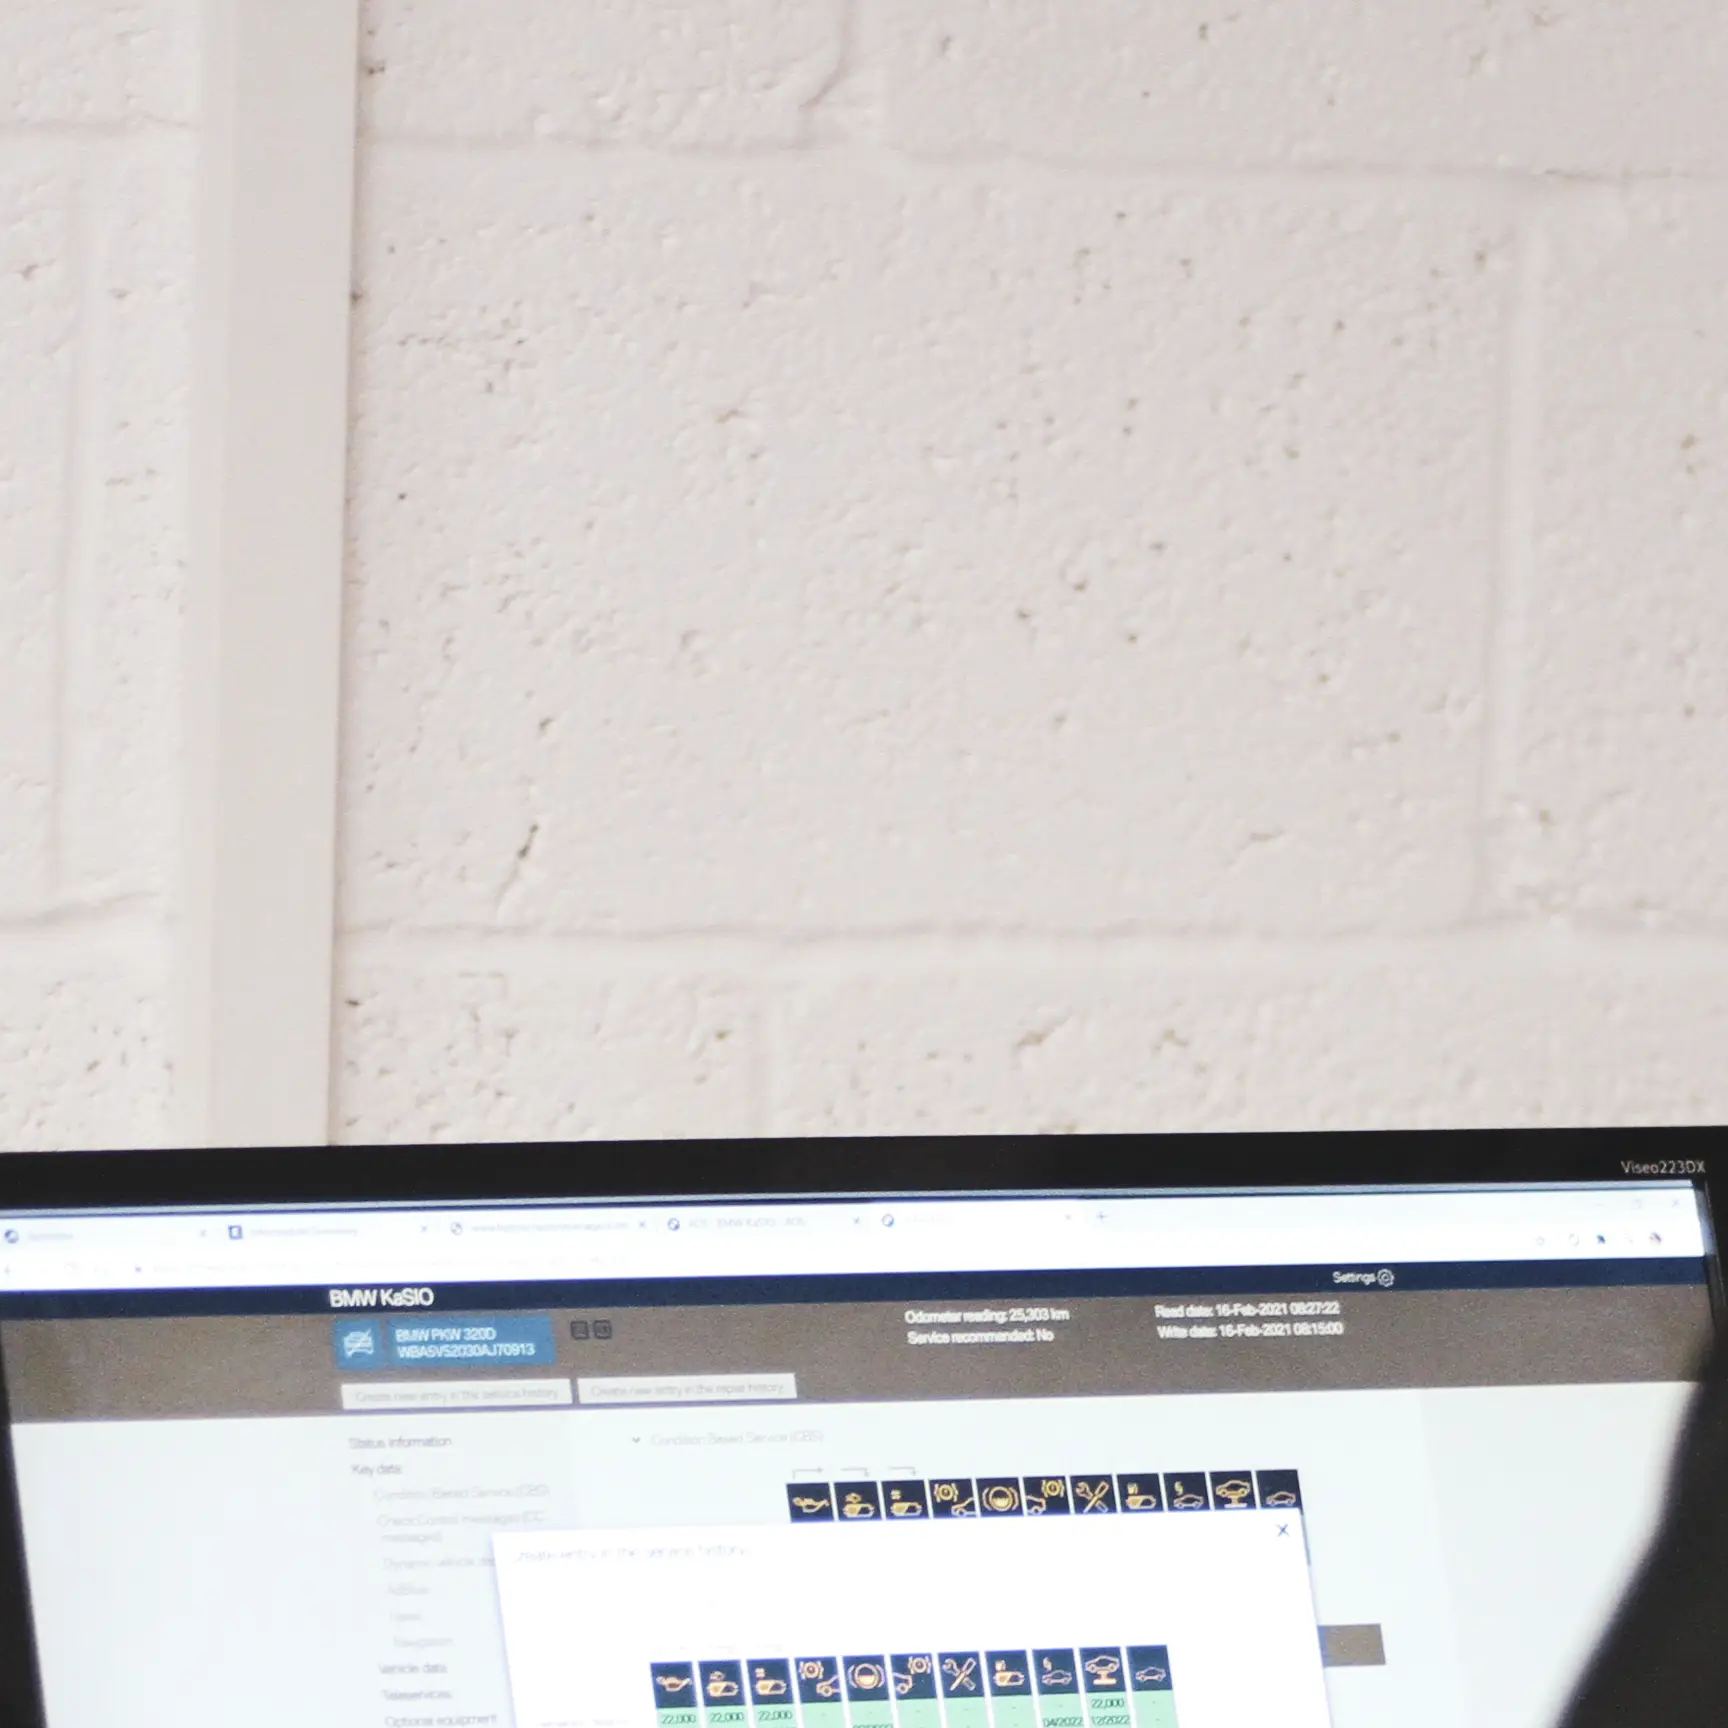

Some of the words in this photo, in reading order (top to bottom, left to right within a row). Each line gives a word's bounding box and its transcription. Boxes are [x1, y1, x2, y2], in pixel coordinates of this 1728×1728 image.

[1332, 1271, 1376, 1285] Settings
[329, 1289, 377, 1307] BMW
[380, 1287, 434, 1306] KaSIO
[904, 1310, 962, 1324] Odometer
[1154, 1304, 1185, 1318] Read
[1215, 1302, 1288, 1316] 16-Feb-2021
[395, 1328, 429, 1342] BMW
[463, 1327, 497, 1341] 320D
[907, 1331, 950, 1345] Service
[1036, 1329, 1055, 1343] No
[1157, 1325, 1188, 1339] Write
[1219, 1323, 1292, 1337] 16-Feb-2021
[348, 1437, 386, 1449] Status
[388, 1435, 452, 1448] information
[350, 1463, 374, 1478] Key
[384, 1715, 434, 1728] Optional
[436, 1713, 498, 1728] equipment
